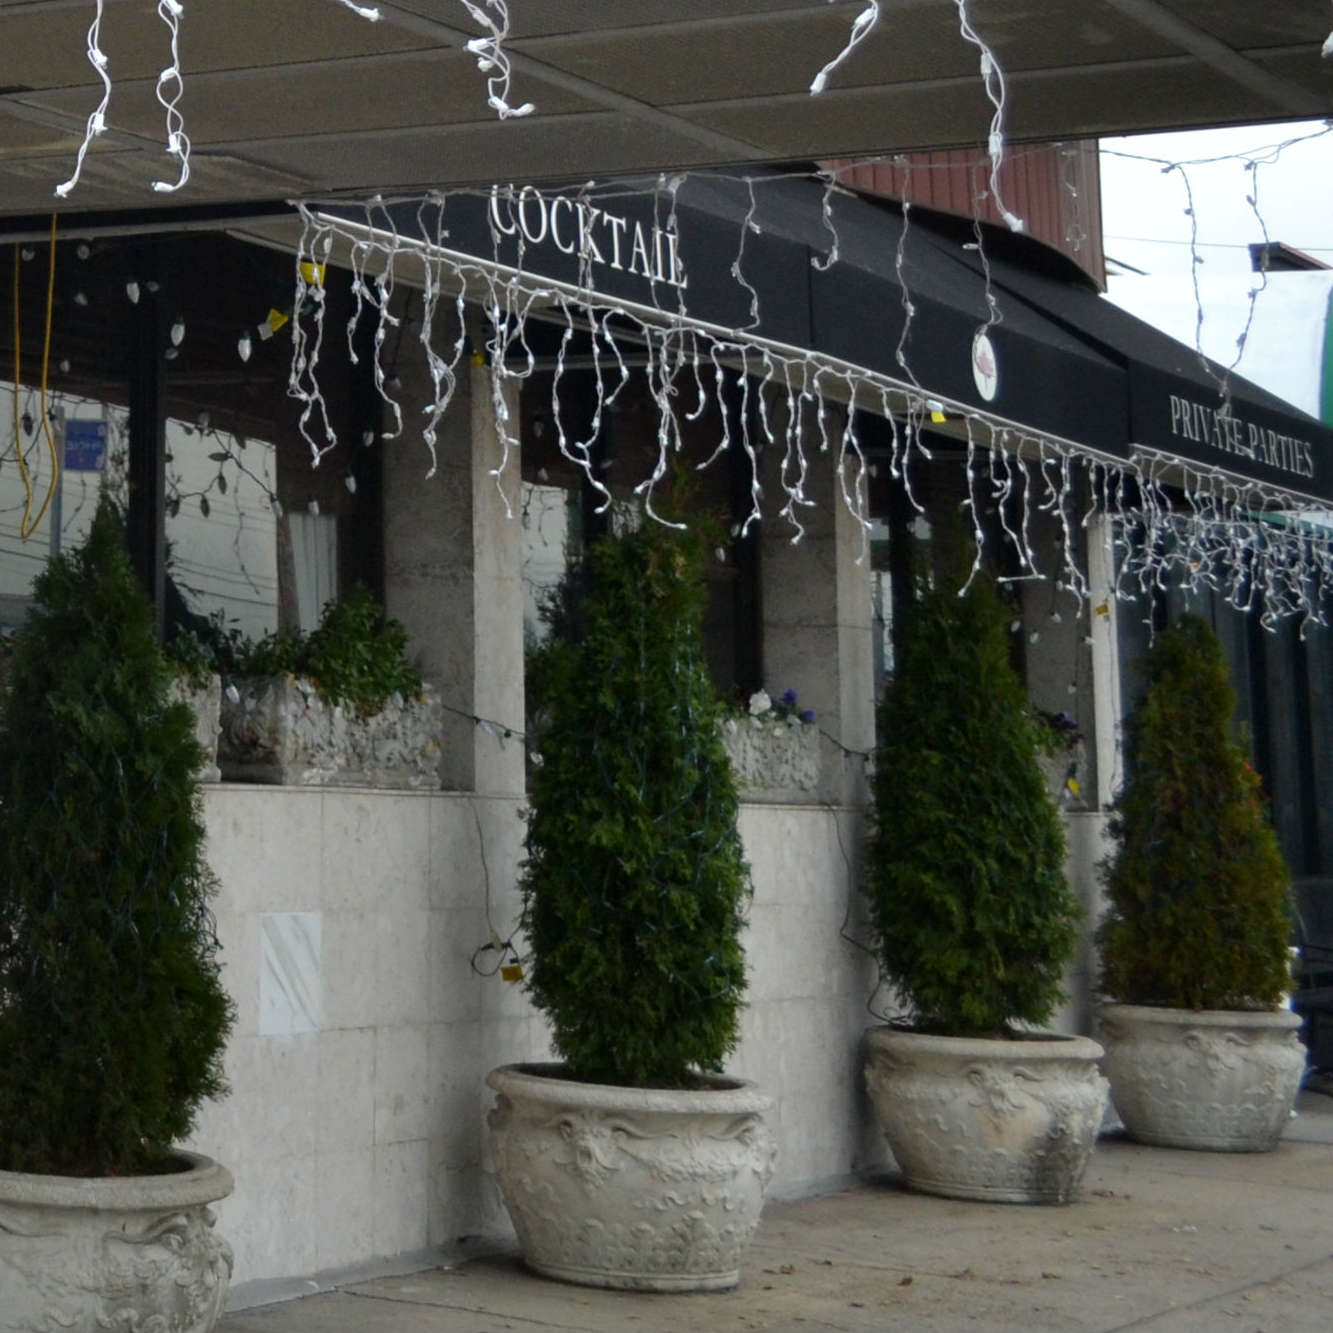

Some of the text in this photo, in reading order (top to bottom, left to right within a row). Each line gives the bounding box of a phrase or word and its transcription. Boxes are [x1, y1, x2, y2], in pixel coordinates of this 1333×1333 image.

[490, 183, 688, 289] COCKTAIL
[1169, 394, 1314, 479] PRIVATE PARTIES
